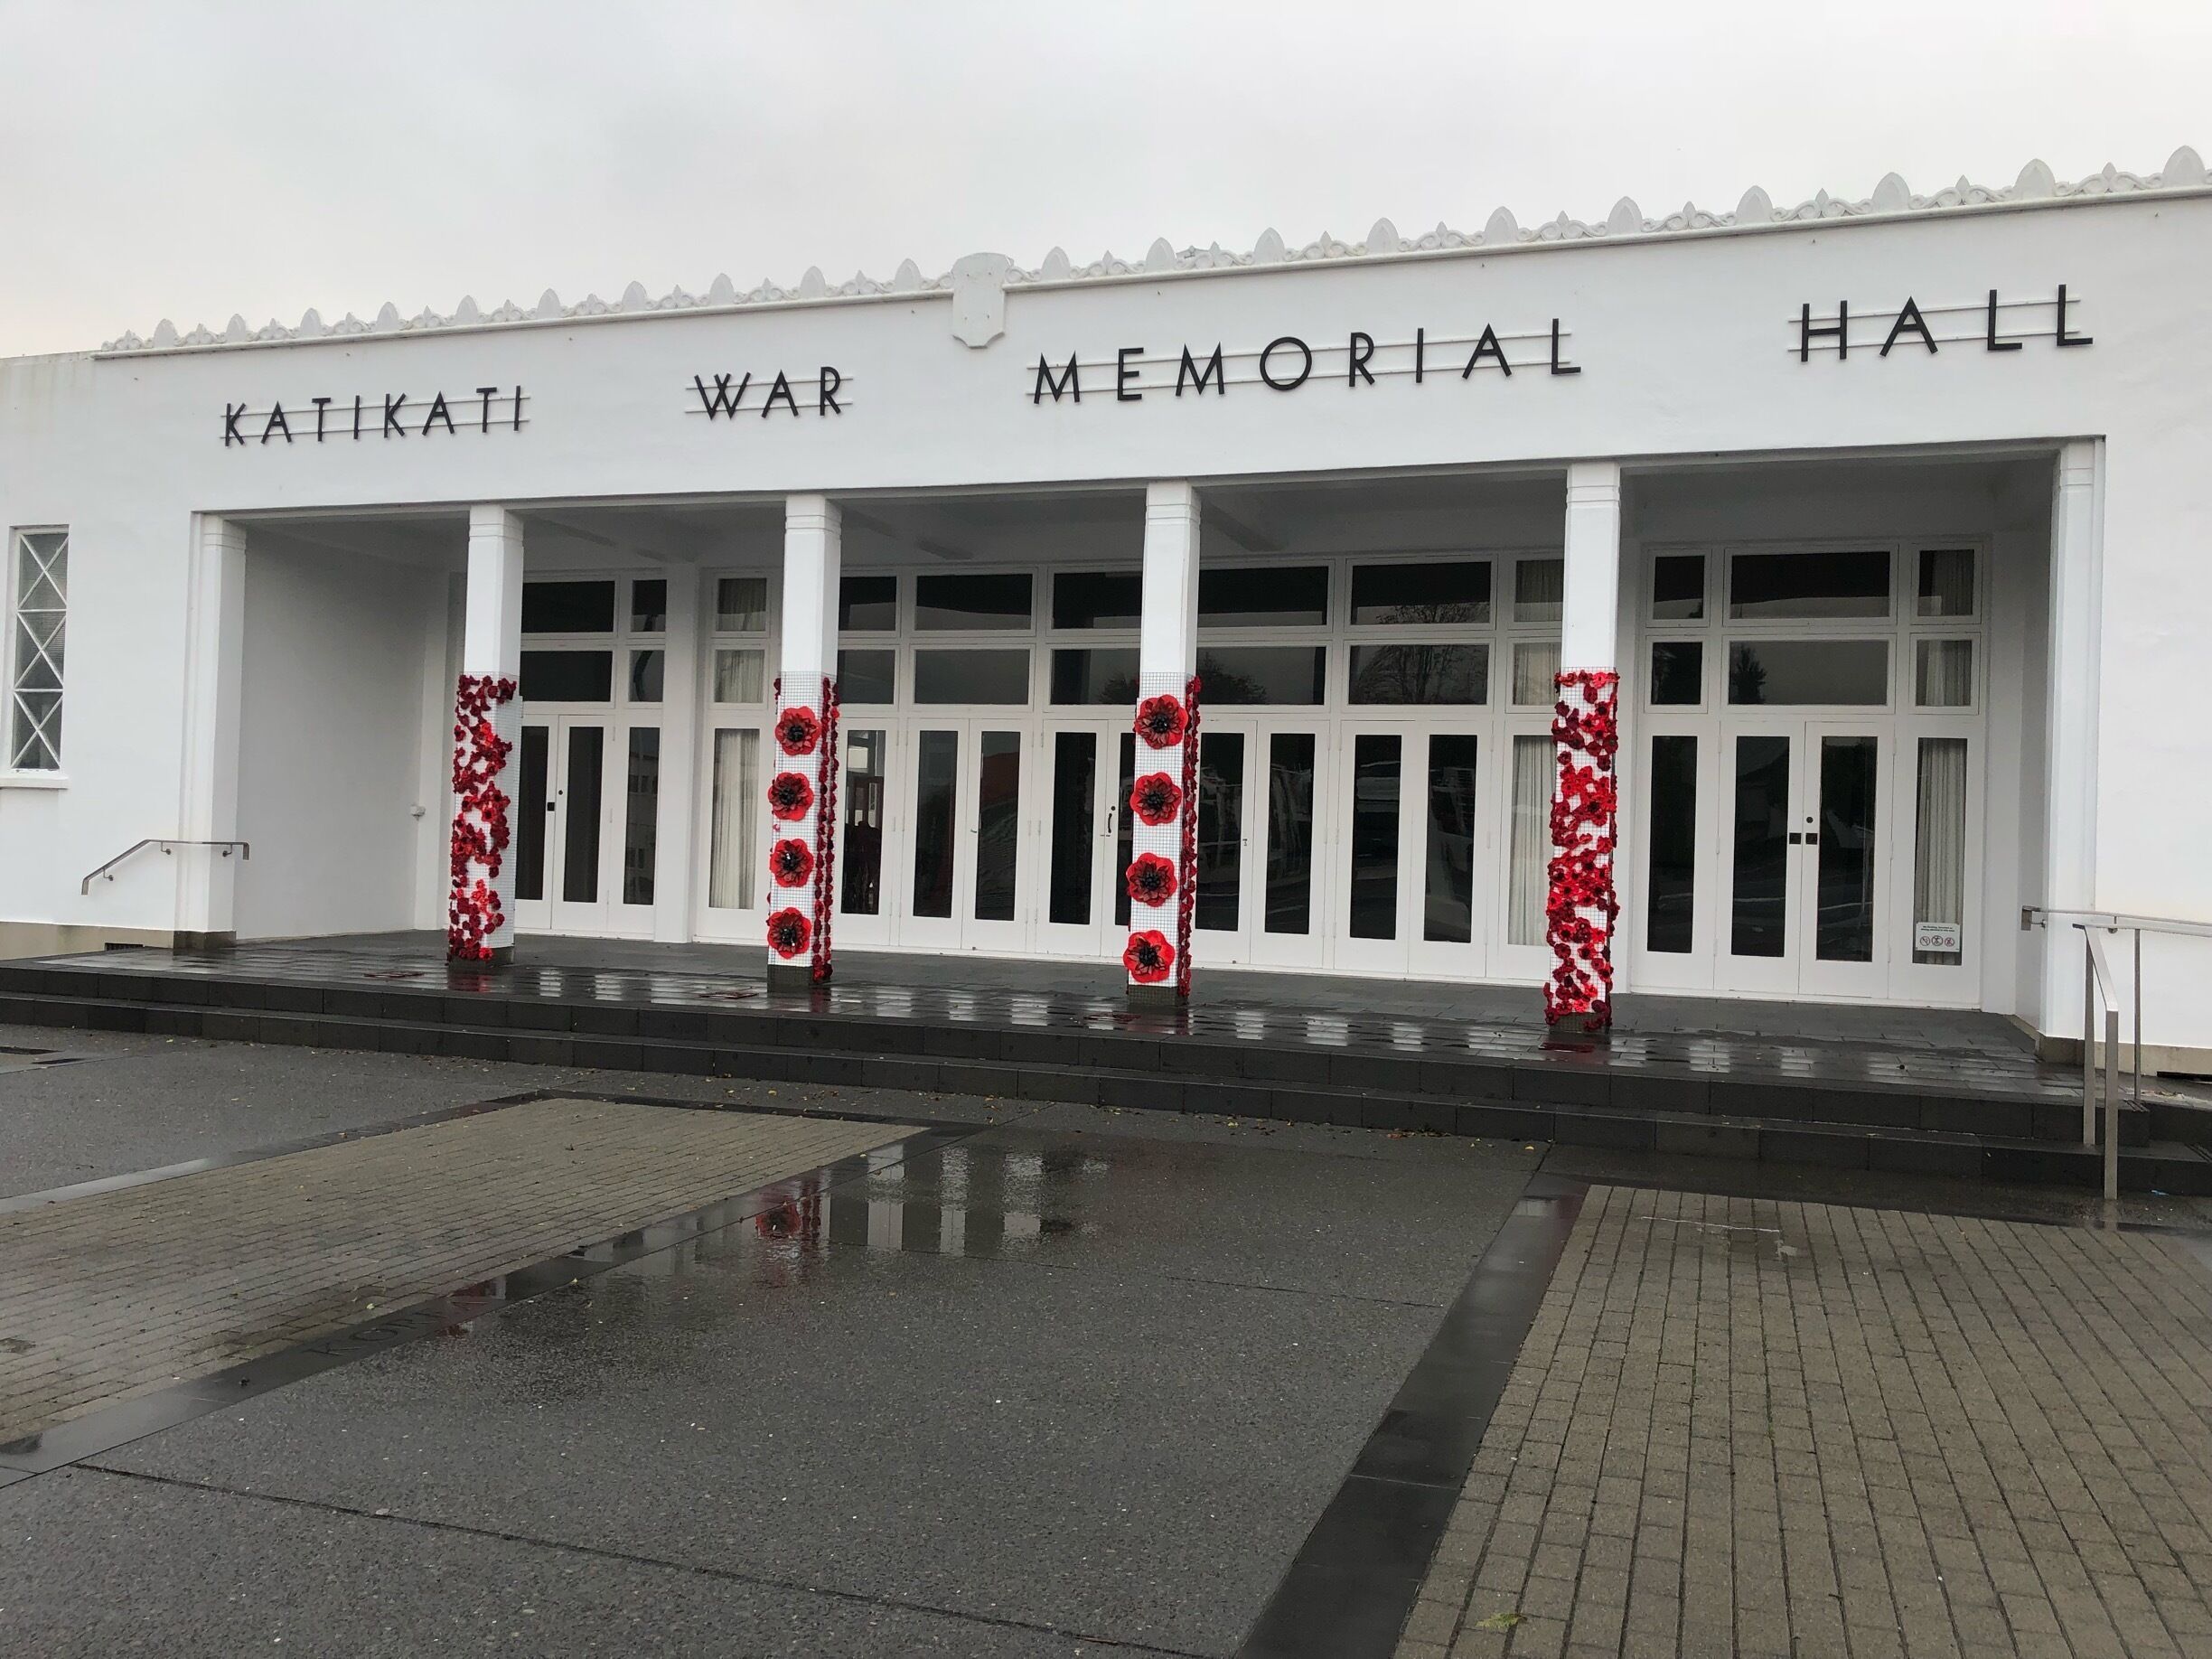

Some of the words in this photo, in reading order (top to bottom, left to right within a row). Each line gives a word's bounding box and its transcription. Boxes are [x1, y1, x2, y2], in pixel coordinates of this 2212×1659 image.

[225, 385, 524, 447] KATIKATI
[695, 367, 844, 420] WAR
[1034, 318, 1581, 405] MEMORIAL
[1800, 284, 2094, 362] HALL
